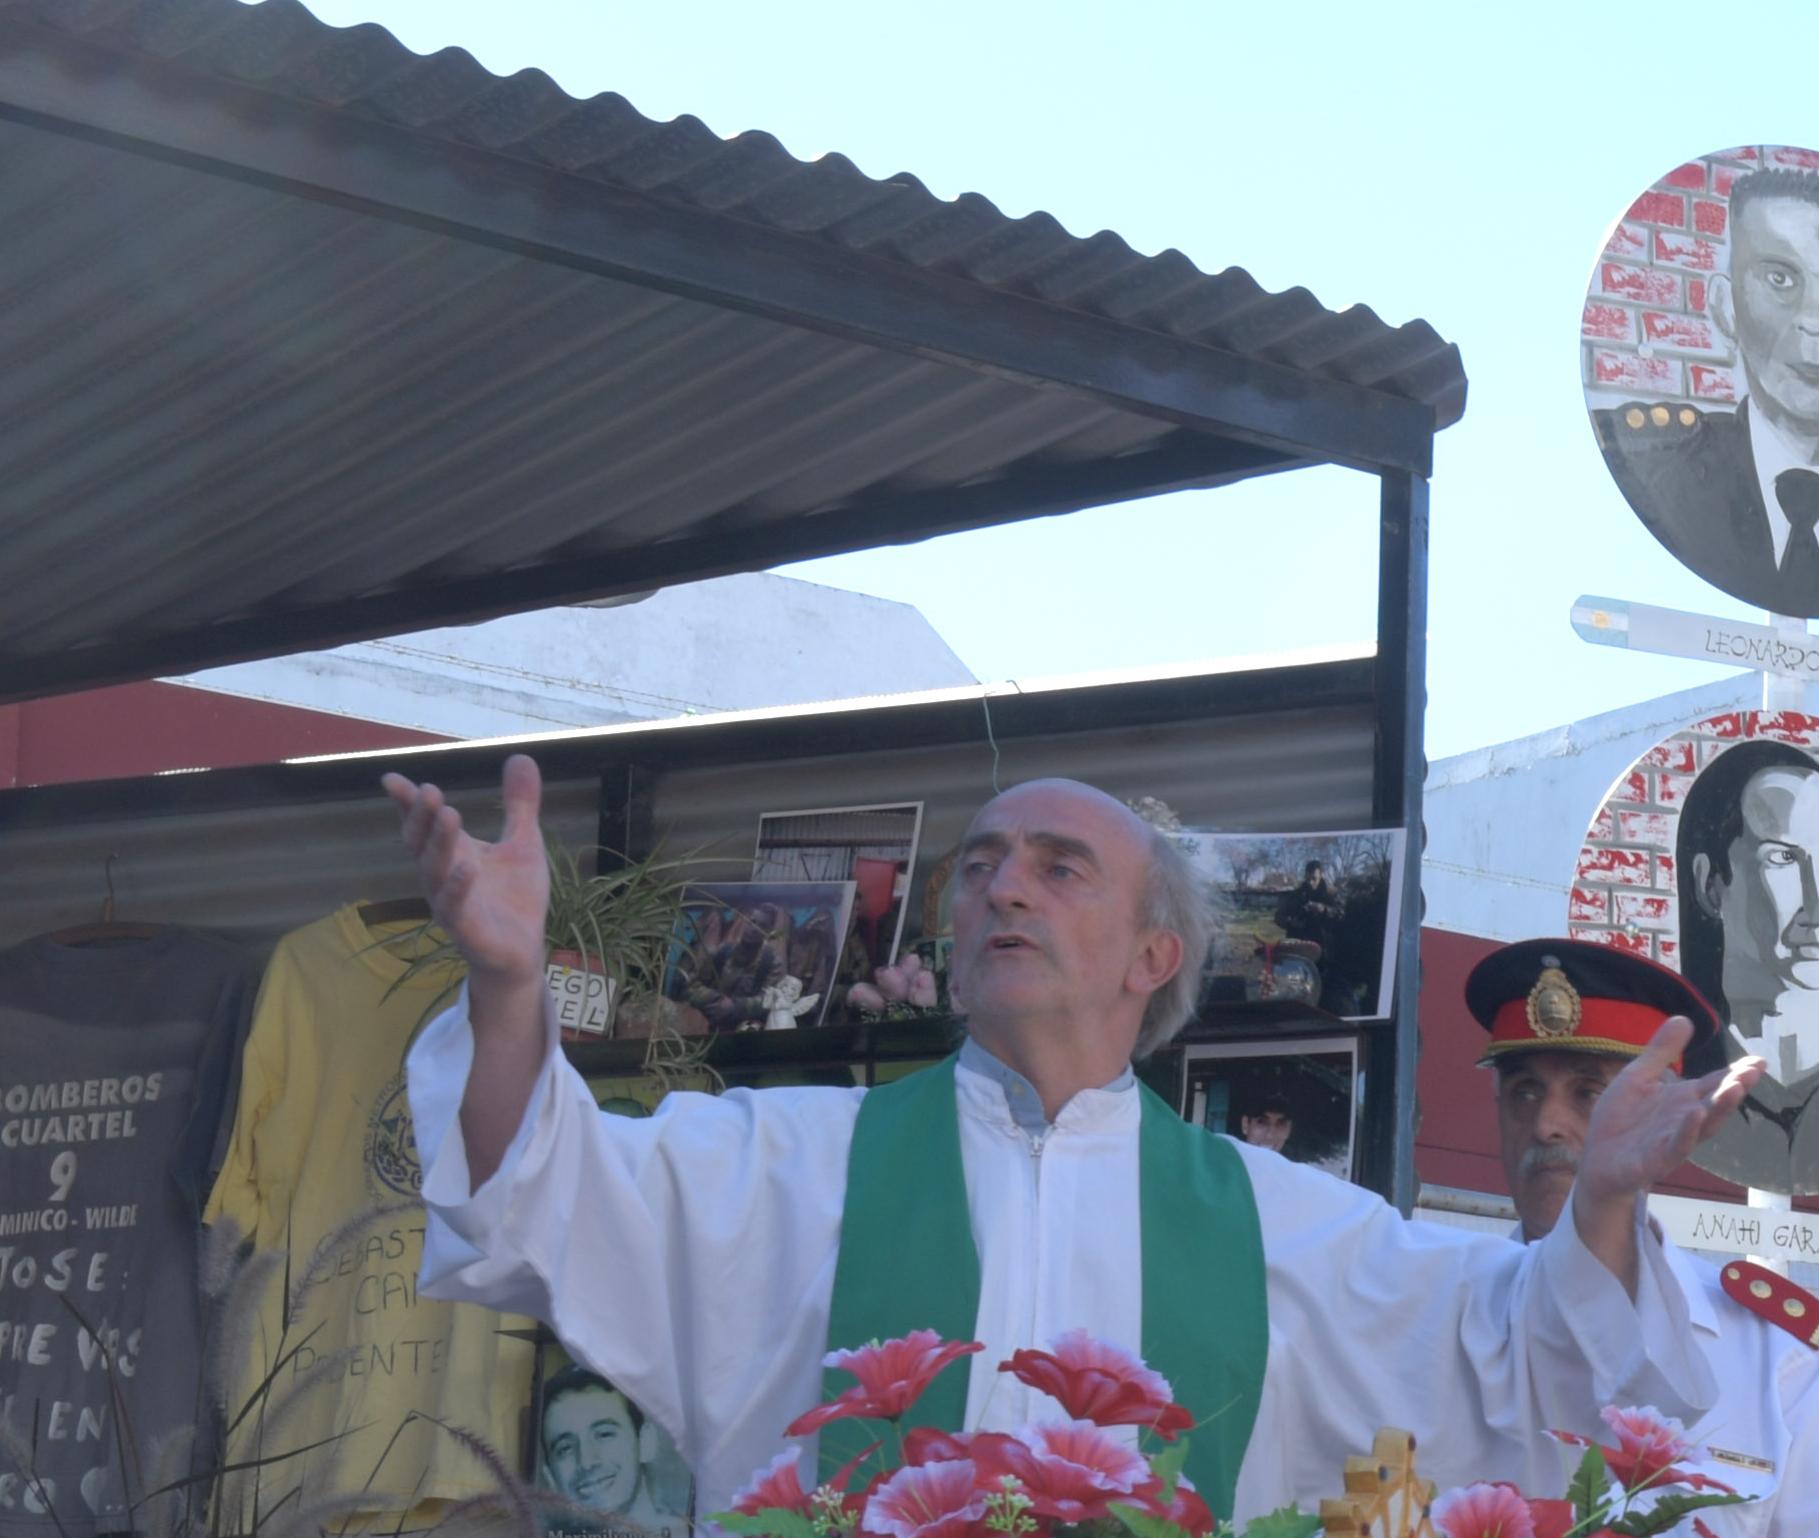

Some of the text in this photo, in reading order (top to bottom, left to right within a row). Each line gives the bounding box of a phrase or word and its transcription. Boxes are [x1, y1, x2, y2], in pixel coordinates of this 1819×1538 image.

[0, 1071, 164, 1114] OMBEROS
[1, 1109, 138, 1148] CUARTEL
[47, 1150, 78, 1202] 9
[1691, 1212, 1761, 1247] ANAHI
